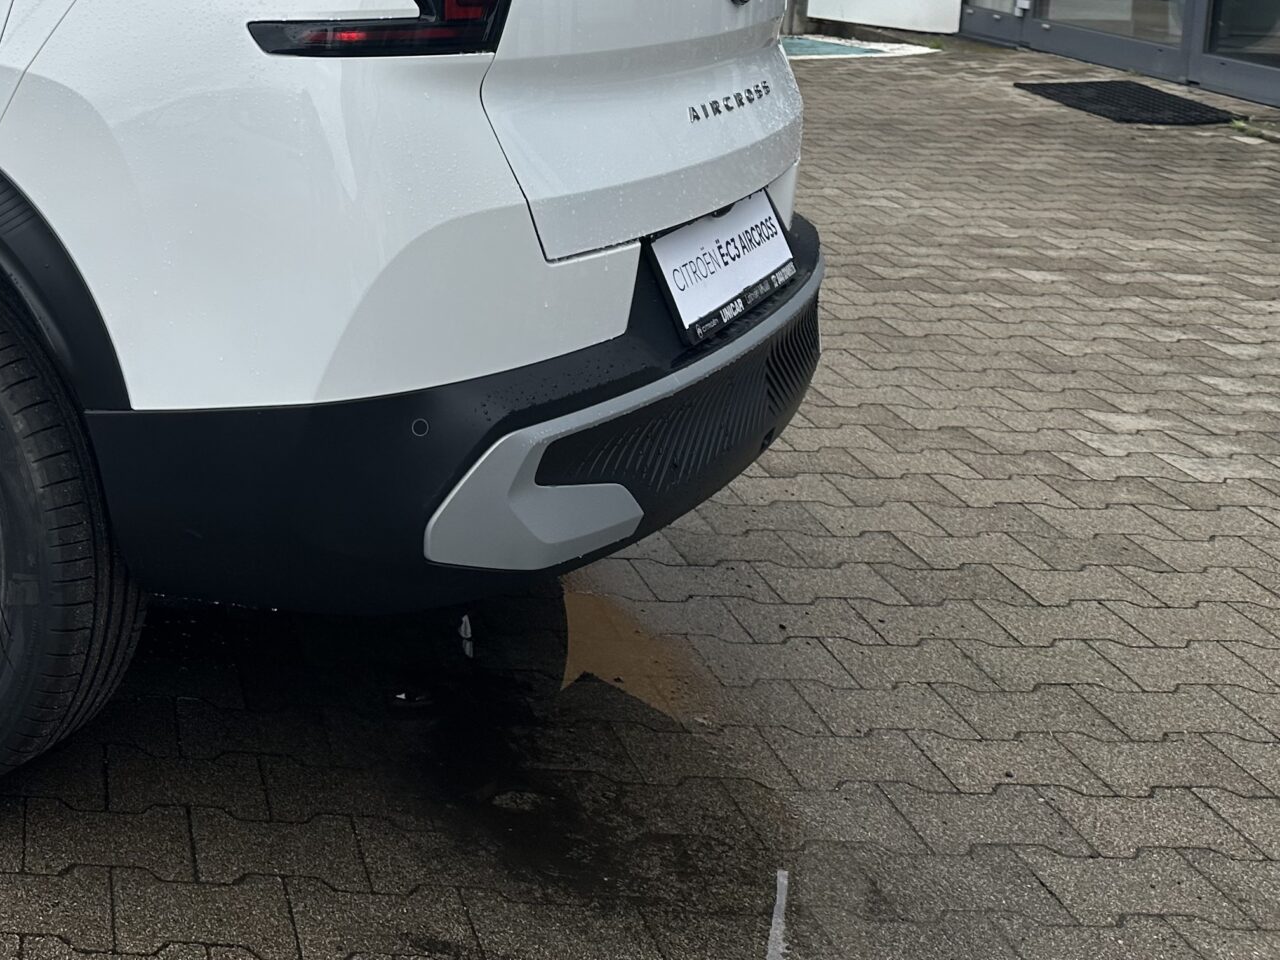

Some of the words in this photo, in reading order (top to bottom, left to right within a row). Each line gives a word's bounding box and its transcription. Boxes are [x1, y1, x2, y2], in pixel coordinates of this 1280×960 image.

[688, 79, 771, 123] AIRCROSS
[672, 246, 721, 292] CITROËN
[738, 215, 779, 257] AIRCROSS
[719, 298, 746, 324] UNICAR
